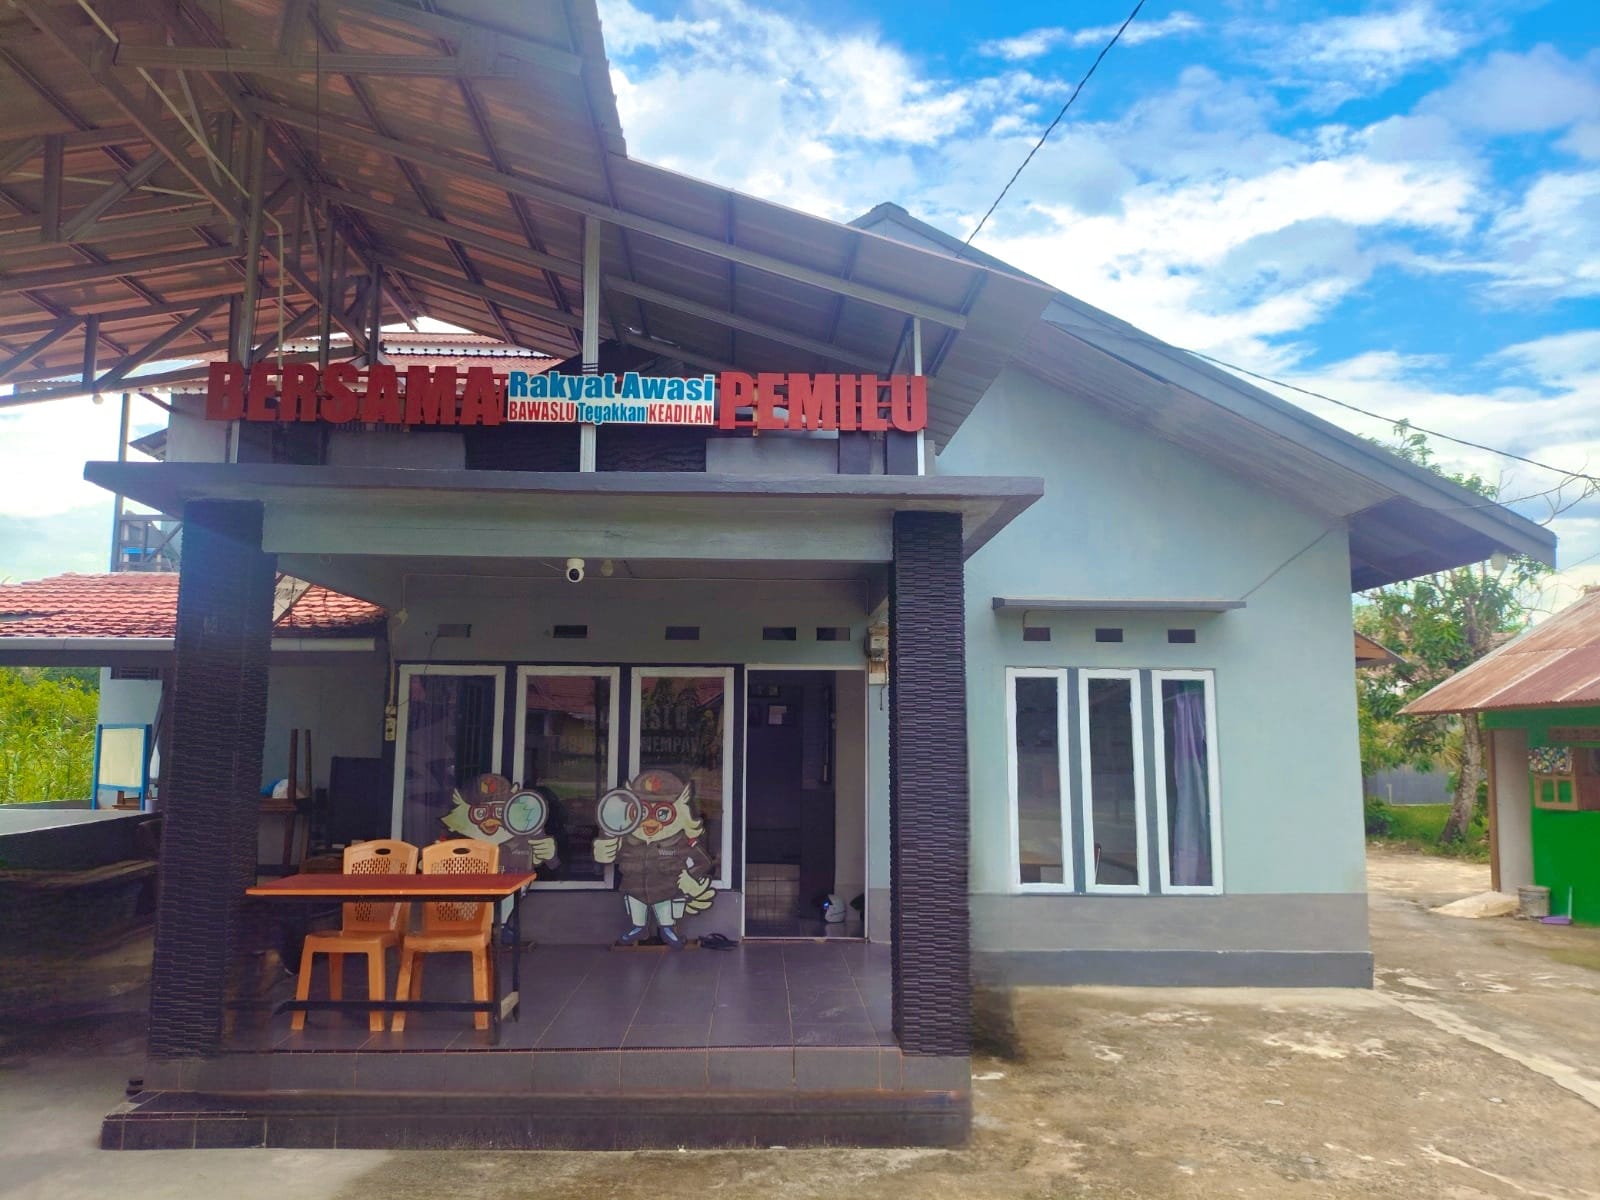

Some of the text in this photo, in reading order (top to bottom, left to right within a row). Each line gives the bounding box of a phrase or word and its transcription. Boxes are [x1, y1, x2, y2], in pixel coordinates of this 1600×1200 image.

[205, 361, 500, 426] BERSAMA
[509, 371, 715, 401] Rakyat Awasi
[719, 371, 928, 432] PEMILU
[509, 401, 713, 424] BAWASLU Tegakkan KEADILAN
